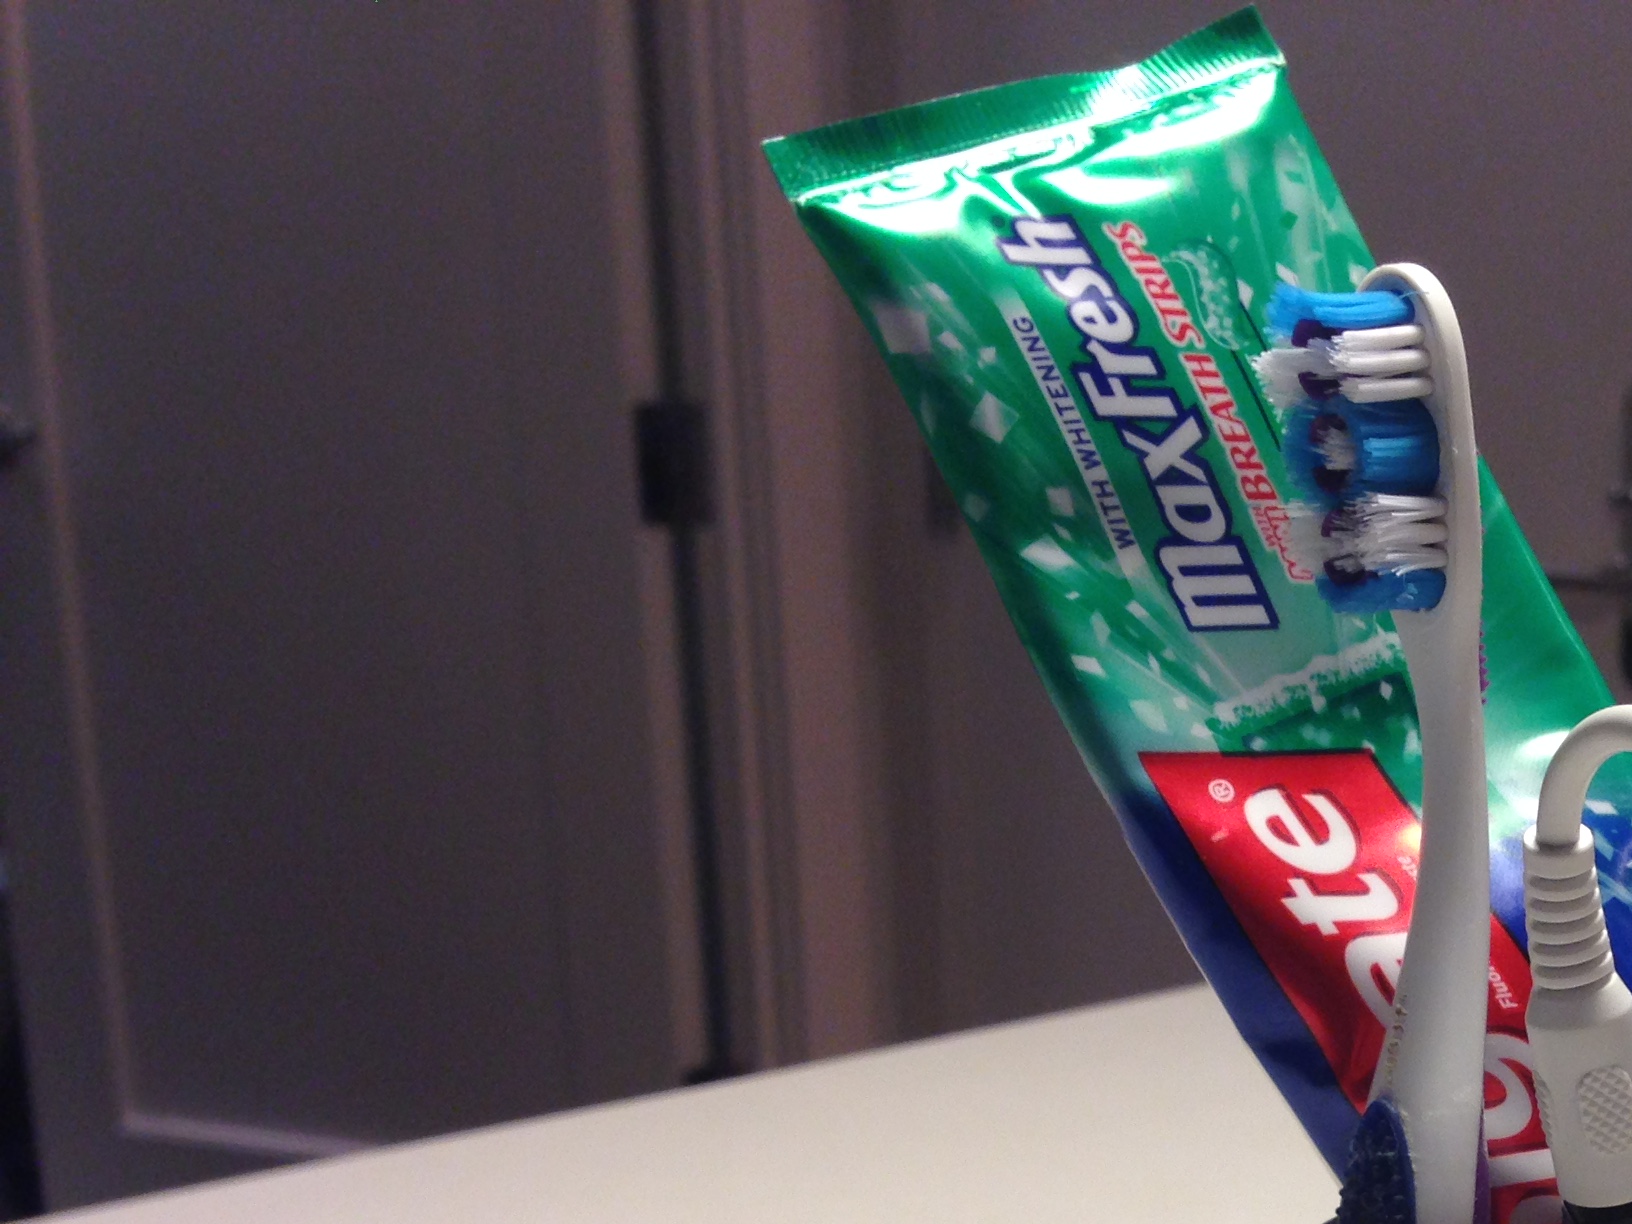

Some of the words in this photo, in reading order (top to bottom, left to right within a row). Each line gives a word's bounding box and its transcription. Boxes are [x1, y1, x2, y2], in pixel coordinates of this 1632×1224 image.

[1104, 220, 1205, 348] STRIPS
[1013, 315, 1103, 472] WHITENING
[1182, 352, 1278, 502] BREATH
[1096, 479, 1136, 550] WITH
